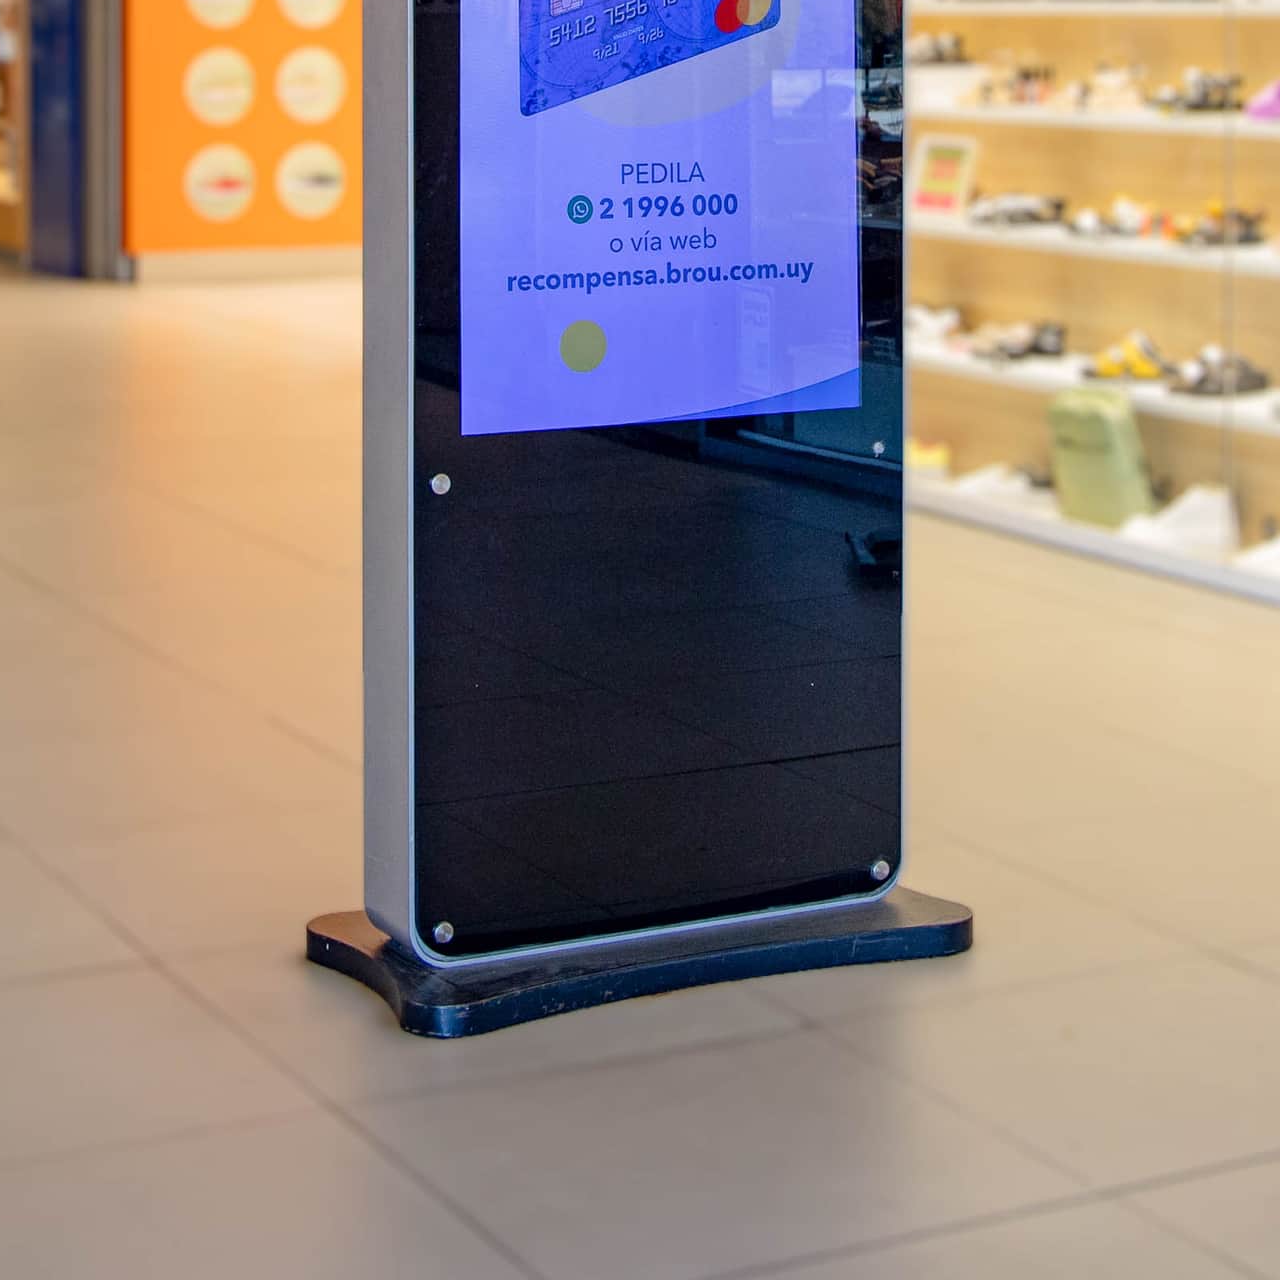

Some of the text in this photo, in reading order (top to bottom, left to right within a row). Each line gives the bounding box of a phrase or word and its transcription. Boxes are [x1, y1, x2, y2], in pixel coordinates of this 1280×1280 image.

[549, 14, 596, 47] 5412
[638, 26, 664, 45] 9/26
[592, 41, 620, 60] 9/21
[620, 161, 705, 185] PEDILA
[599, 193, 739, 220] 2 1996 000
[609, 227, 717, 253] o vía web
[507, 261, 814, 295] recompensa.brou.com.uy
